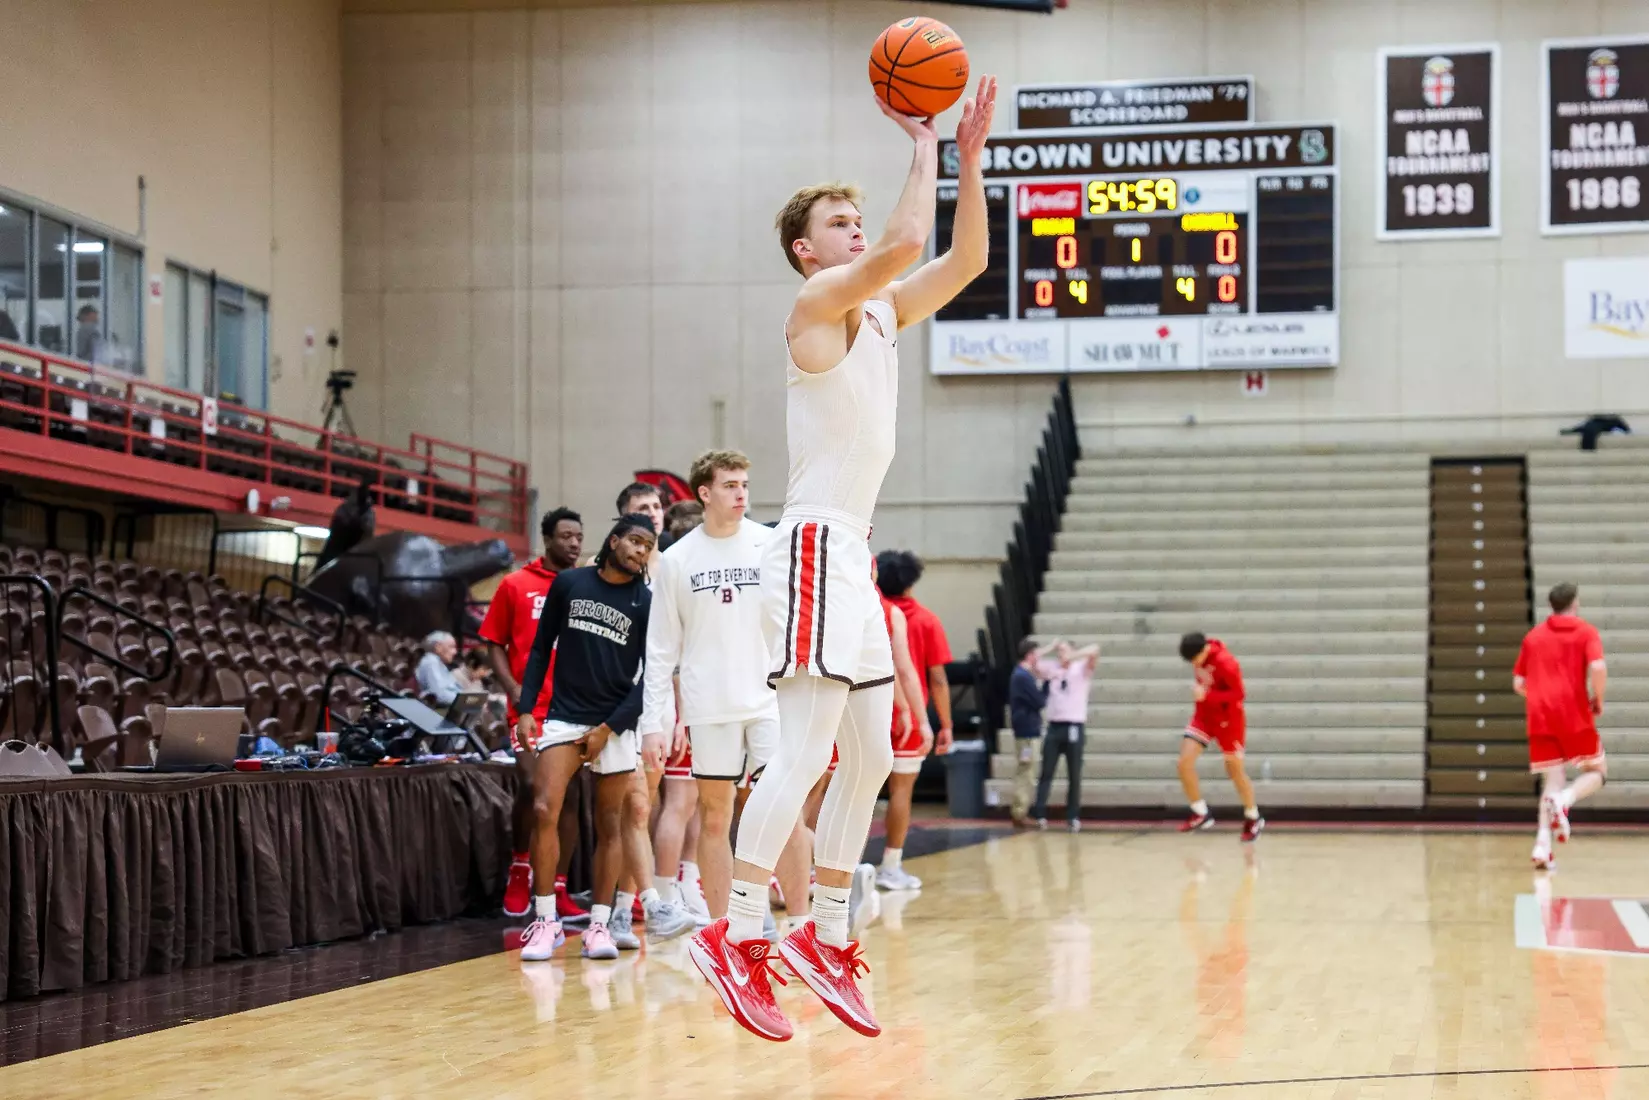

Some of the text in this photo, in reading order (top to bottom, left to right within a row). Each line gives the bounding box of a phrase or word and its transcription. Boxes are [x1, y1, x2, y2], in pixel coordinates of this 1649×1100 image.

[1020, 90, 1097, 109] RICHARD
[1124, 86, 1214, 104] FRIEDMAN
[1070, 104, 1188, 125] SCOREBOARD
[1405, 128, 1470, 155] NCAA
[1569, 120, 1637, 149] NCAA
[1102, 135, 1292, 168] UNIVERSITY
[1388, 152, 1490, 177] TOURNAMENT
[1088, 178, 1177, 215] 54:59
[1402, 182, 1475, 217] 1939
[1566, 175, 1640, 211] 1986
[1056, 235, 1078, 269] 0
[1131, 237, 1141, 262] 1
[1215, 231, 1237, 265] 0
[1035, 280, 1053, 307] 0
[1068, 280, 1088, 304] 4
[1176, 277, 1195, 302] 4
[1218, 275, 1236, 303] 0
[690, 572, 706, 588] NOT
[708, 570, 722, 585] FOR
[721, 588, 733, 605] B
[569, 599, 632, 636] BROWN
[568, 618, 628, 645] BASKETBALL
